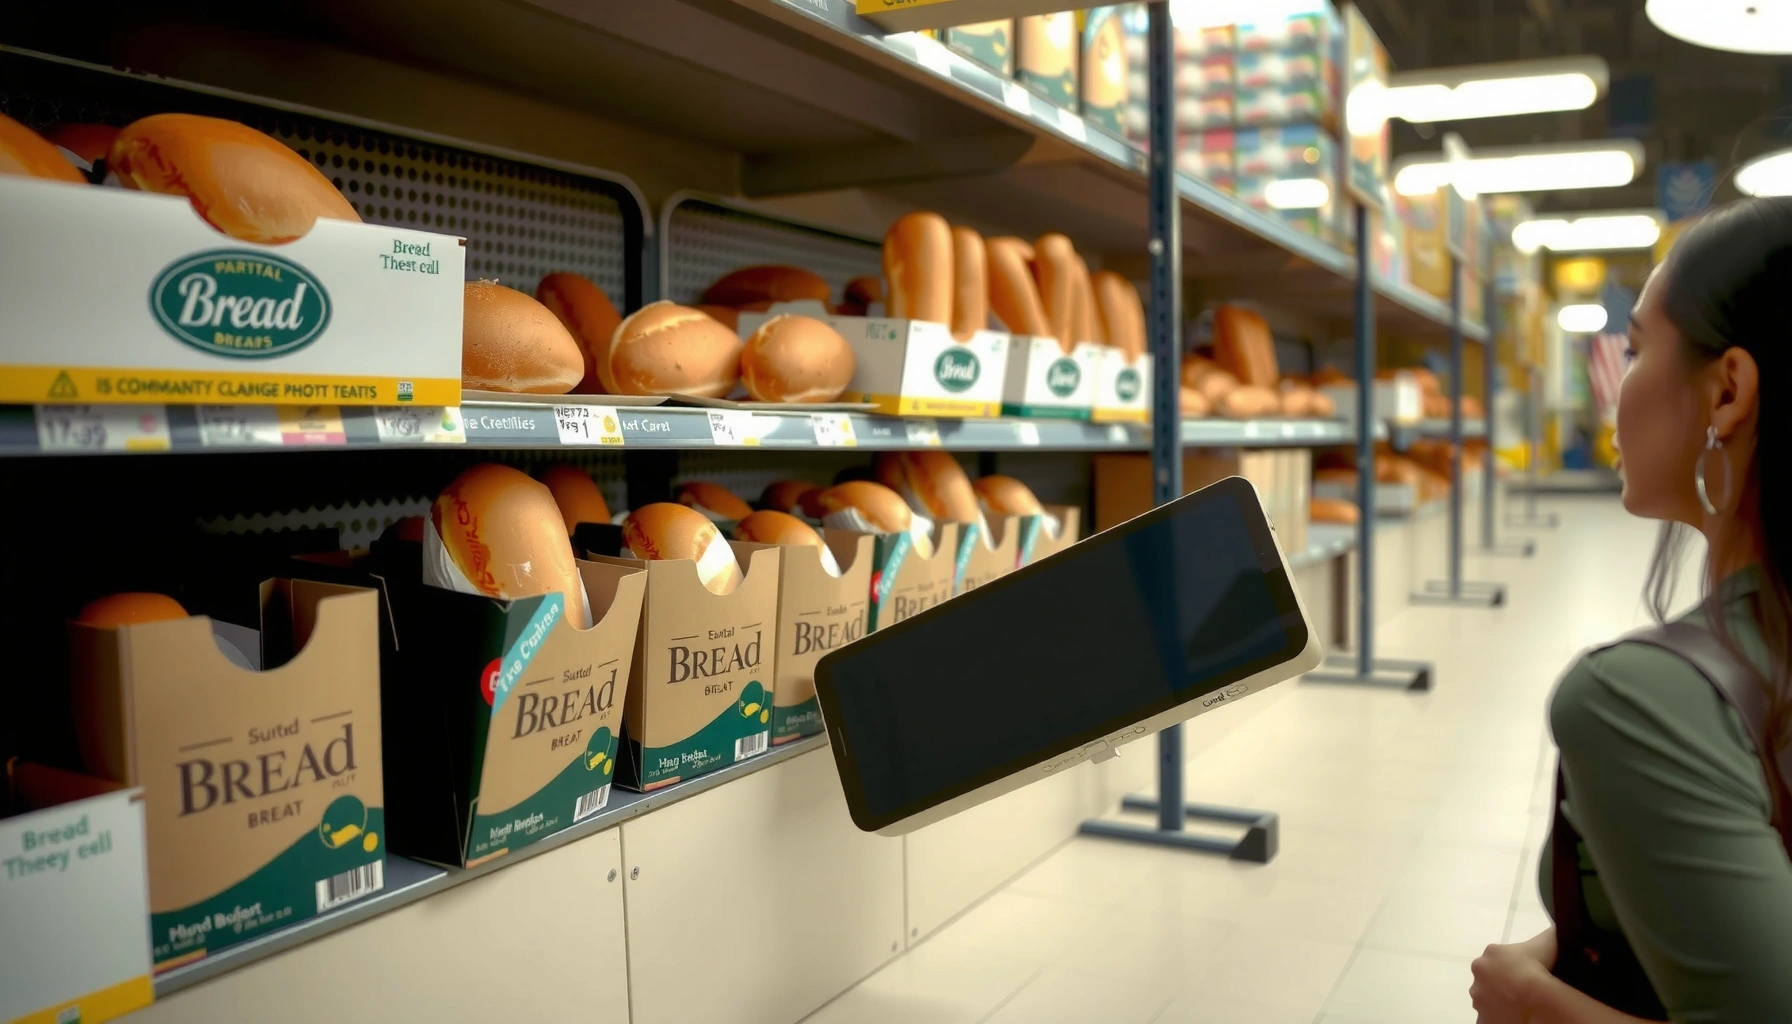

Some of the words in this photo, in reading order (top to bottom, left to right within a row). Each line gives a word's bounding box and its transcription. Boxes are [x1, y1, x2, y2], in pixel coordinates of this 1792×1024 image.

[178, 272, 307, 331] Bread
[22, 813, 90, 852] Bread
[248, 799, 304, 829] BREAT
